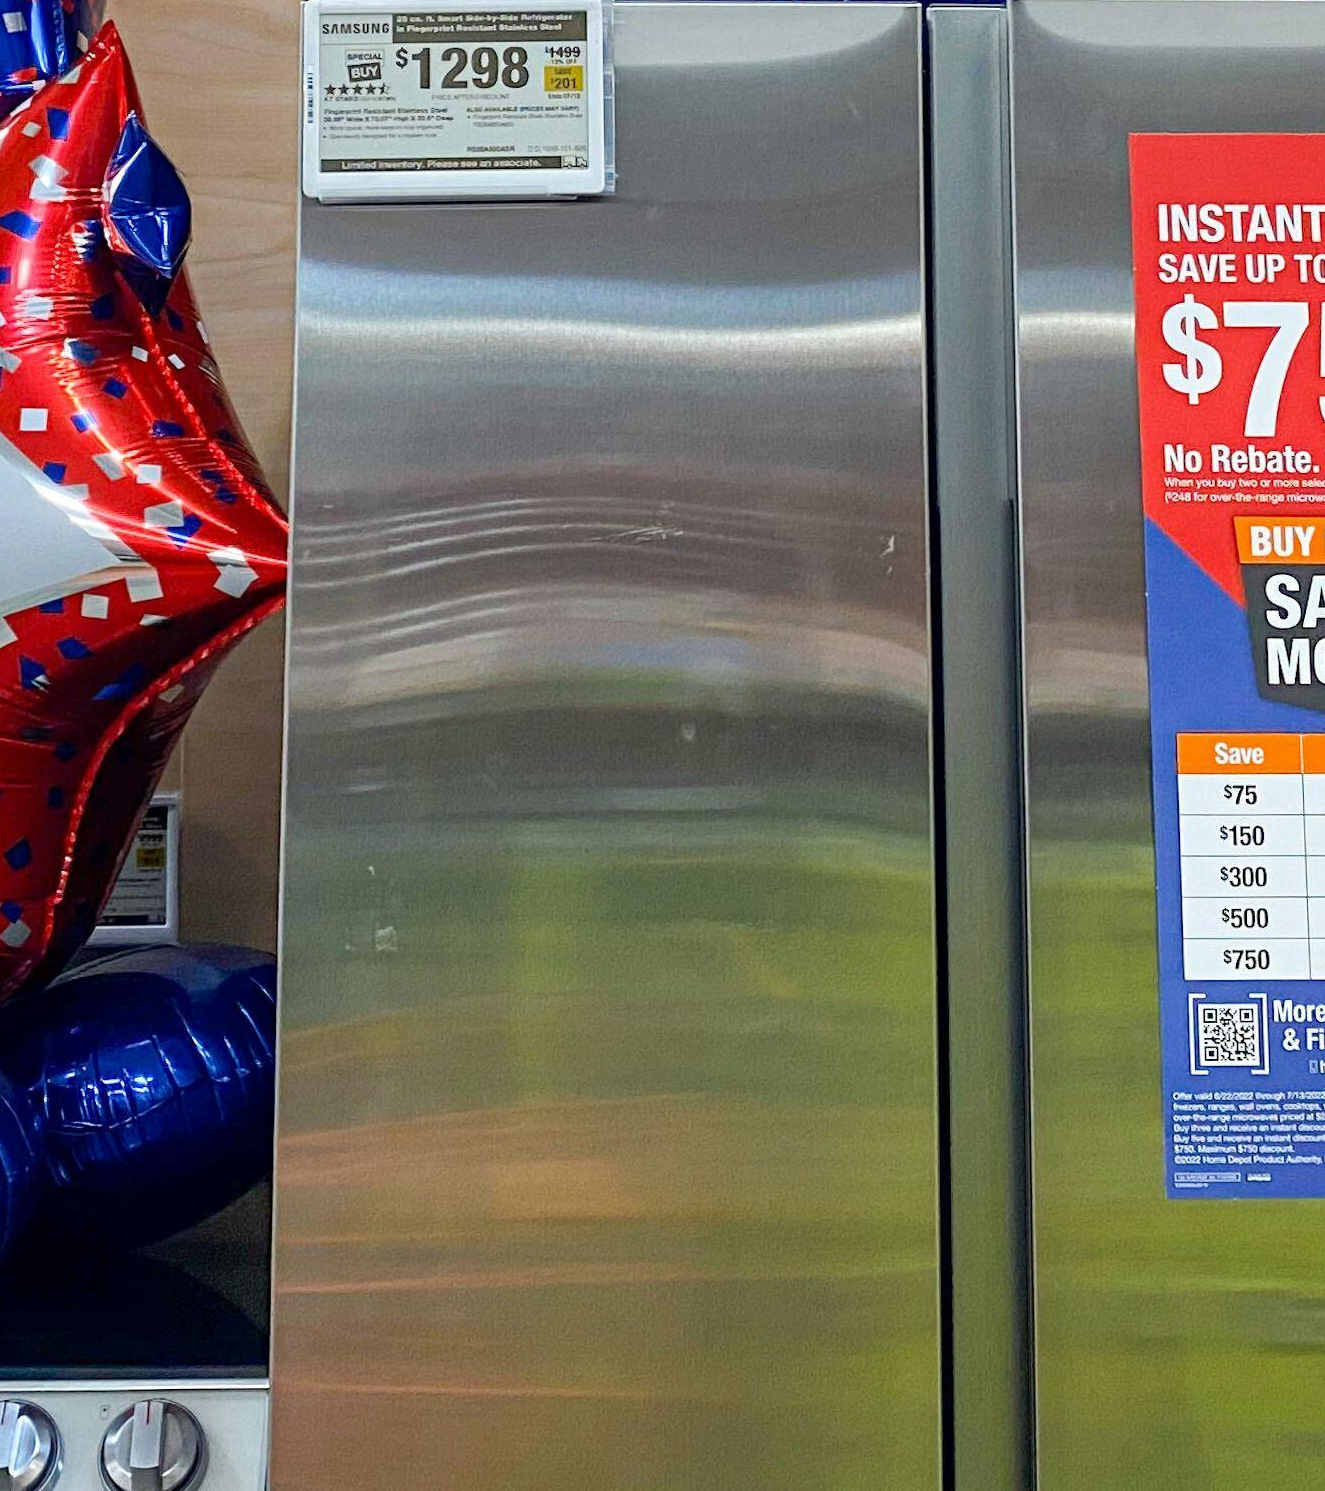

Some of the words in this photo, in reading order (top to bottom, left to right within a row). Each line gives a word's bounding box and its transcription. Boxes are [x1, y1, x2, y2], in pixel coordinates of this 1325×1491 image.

[322, 23, 390, 35] SAMSUNG
[347, 53, 382, 61] SPECIAL
[395, 46, 530, 89] $1298
[350, 65, 379, 79] BUY
[550, 77, 577, 89] $201
[341, 161, 376, 170] Limited
[378, 160, 425, 170] Inventory.
[427, 160, 458, 168] Please
[493, 159, 542, 168] associate.
[1158, 253, 1238, 284] SAVE
[1245, 254, 1286, 284] UP
[1163, 444, 1203, 474] No
[1211, 444, 1320, 474] Rebate.
[1164, 477, 1194, 488] When
[1195, 479, 1216, 490] you
[1217, 478, 1237, 490] buy
[1238, 479, 1258, 488] two
[1260, 480, 1271, 488] or
[1273, 480, 1300, 488] more
[1164, 492, 1192, 504] ($248
[1193, 492, 1208, 501] for
[1210, 492, 1285, 504] over-the-range
[1250, 525, 1314, 557] BUY
[1214, 743, 1264, 764] Save
[1223, 784, 1258, 806] $75
[1219, 825, 1265, 847] $150
[1220, 866, 1267, 888] $300
[1221, 907, 1269, 929] $500
[1223, 948, 1270, 970] $750
[1283, 1030, 1301, 1052] &
[1194, 1091, 1213, 1101] valid
[1255, 1091, 1286, 1102] through
